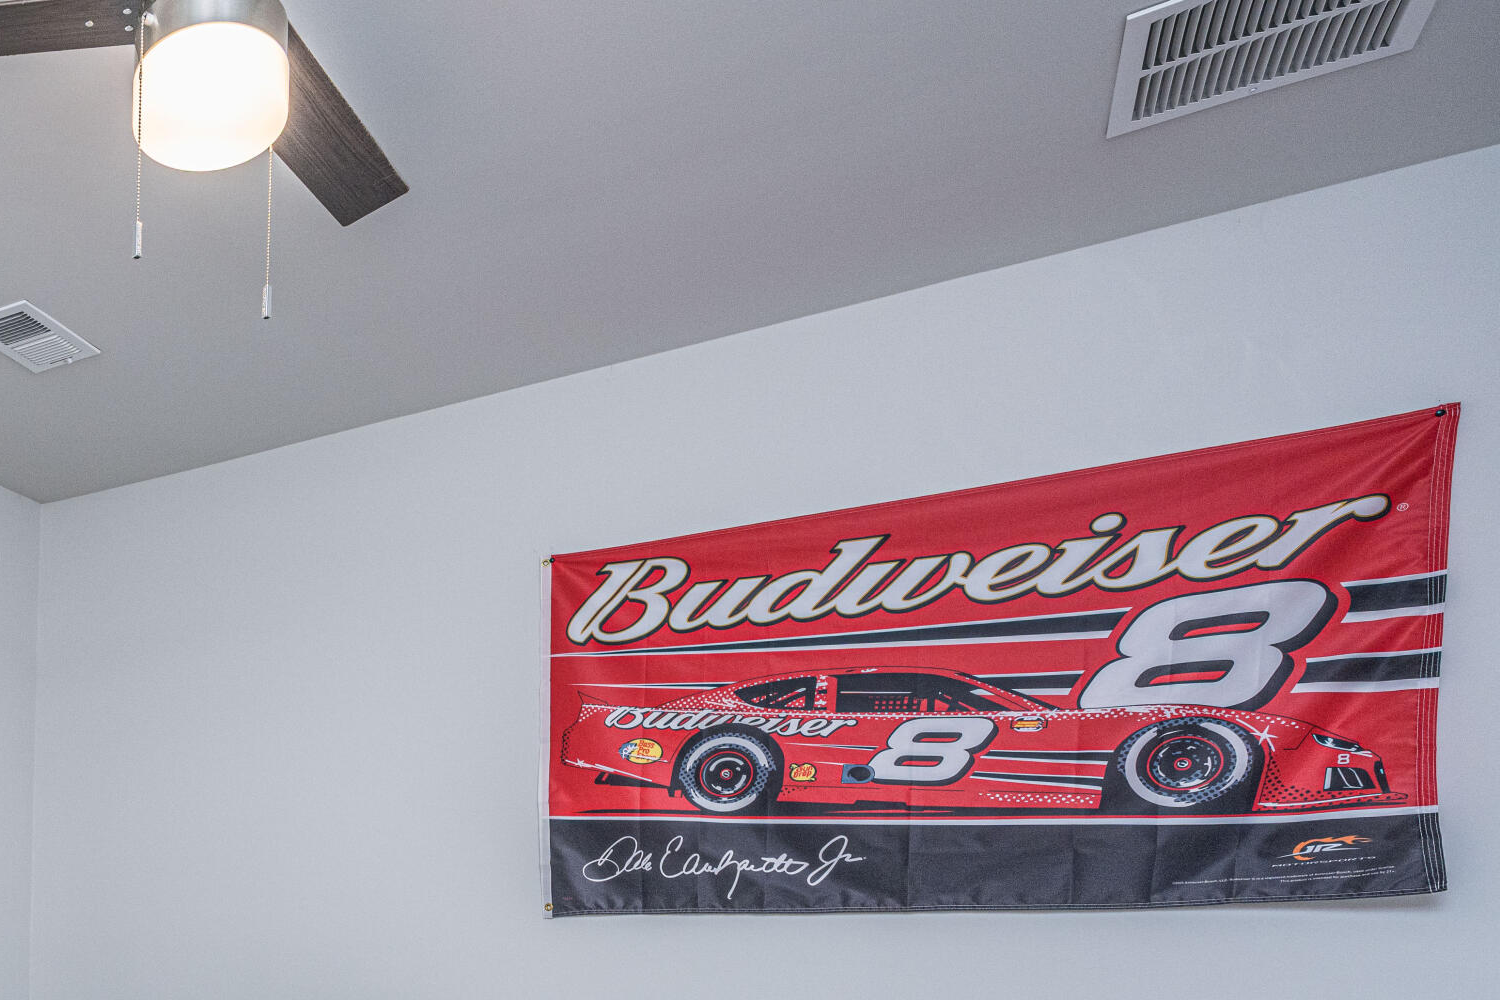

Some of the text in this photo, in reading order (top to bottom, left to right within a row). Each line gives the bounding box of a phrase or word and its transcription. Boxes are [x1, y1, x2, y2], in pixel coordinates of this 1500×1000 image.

[566, 493, 1391, 646] Budweiser
[1078, 579, 1338, 709] 8
[867, 717, 998, 785] 8
[1337, 753, 1350, 765] 8
